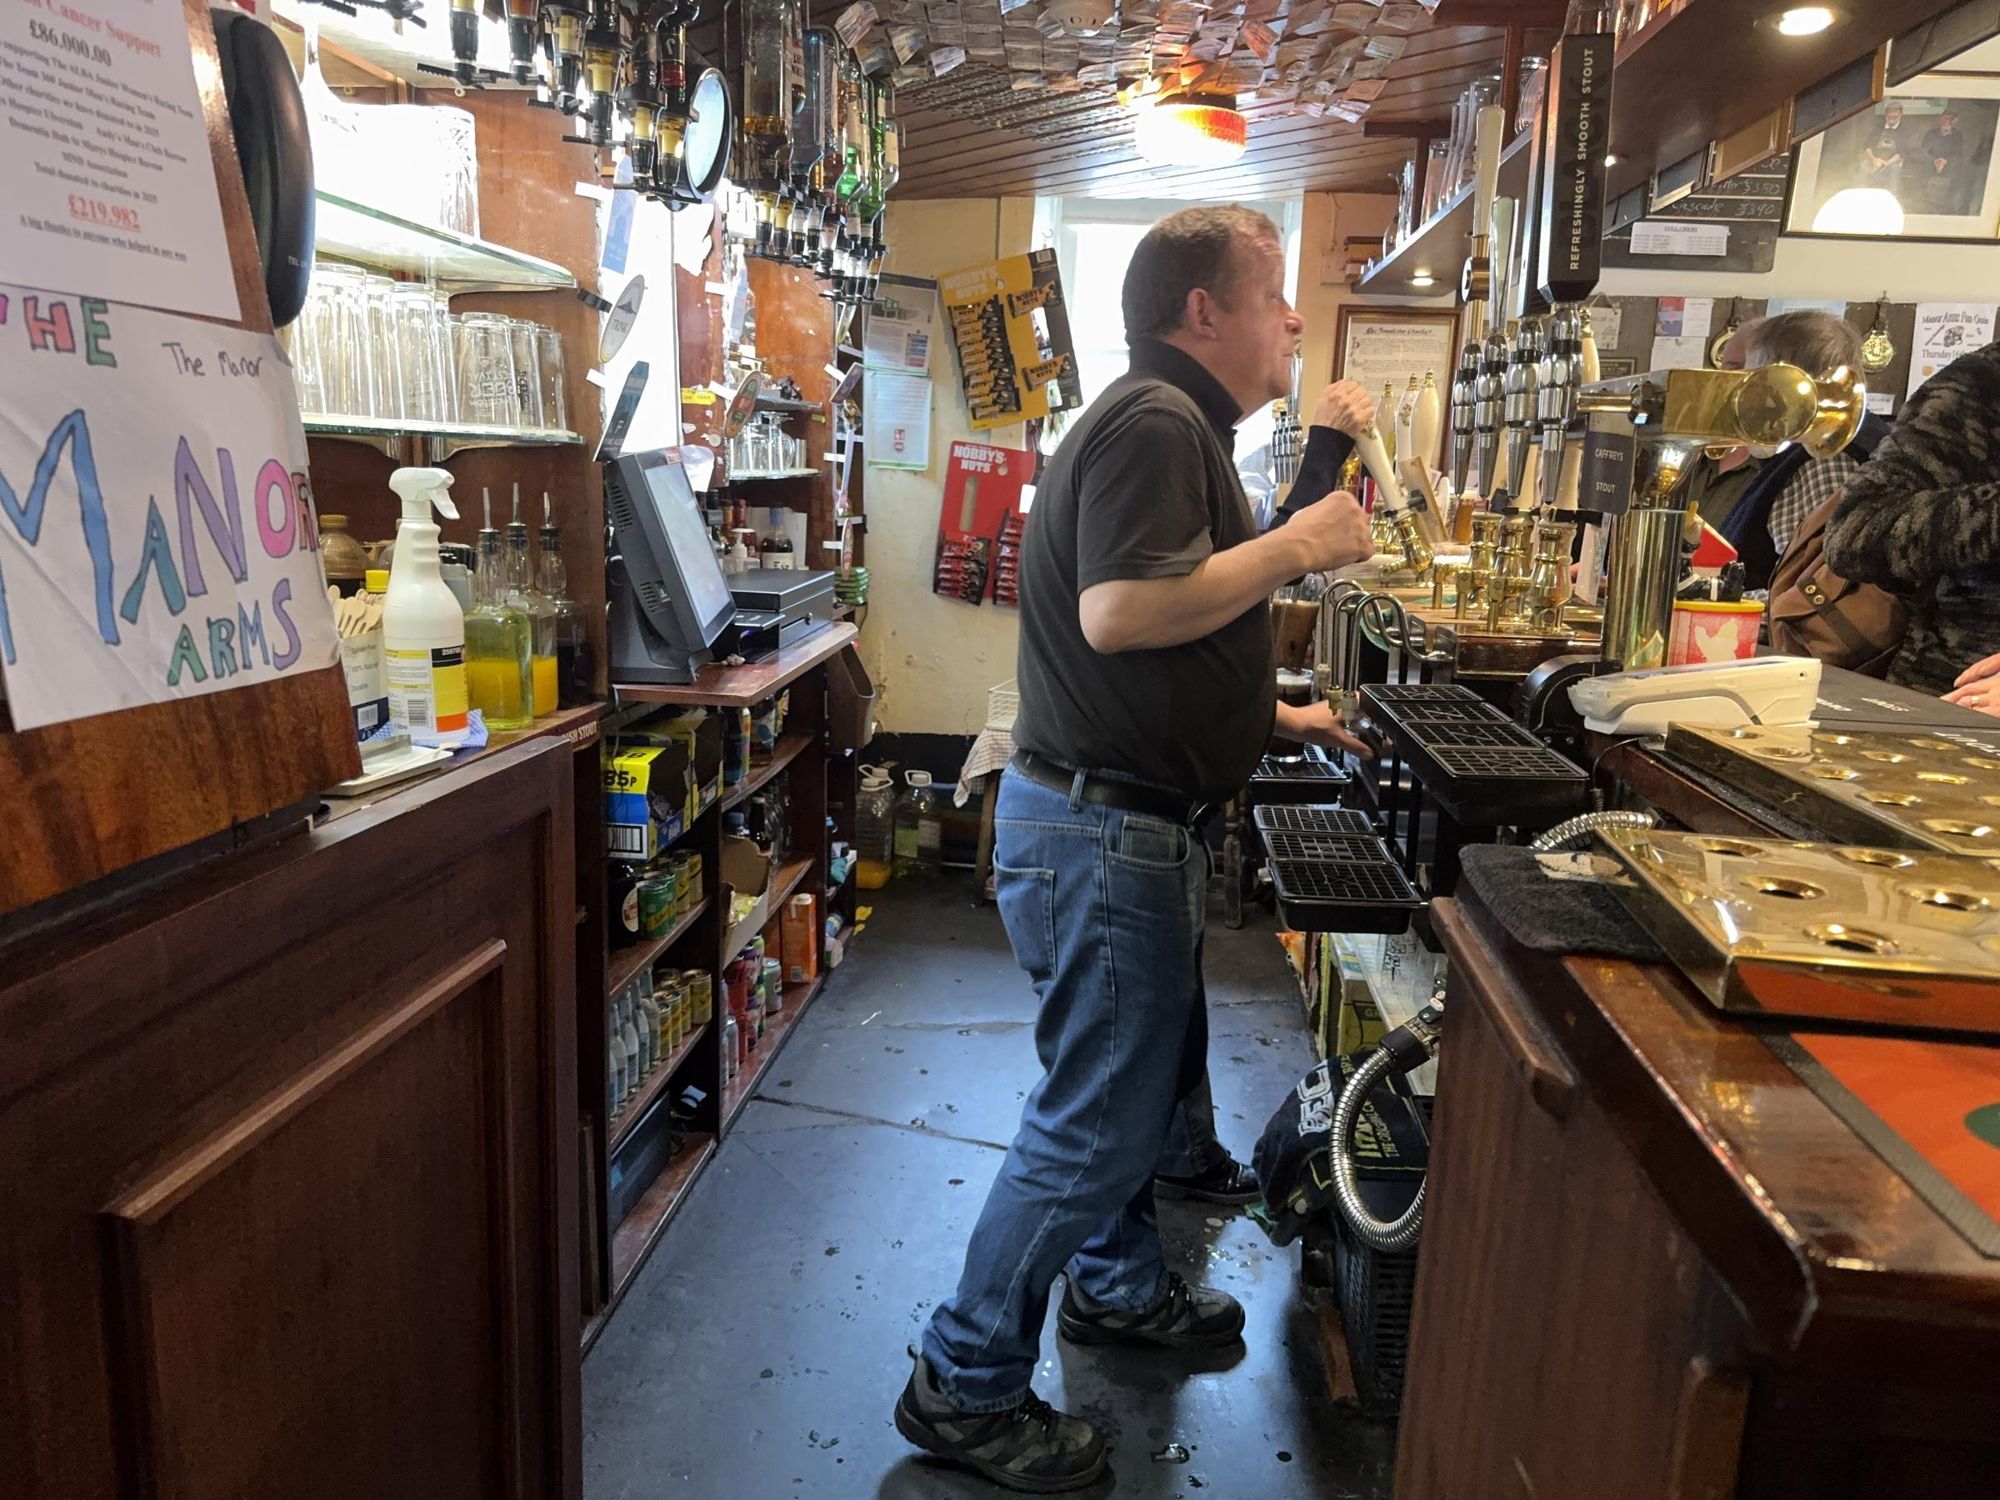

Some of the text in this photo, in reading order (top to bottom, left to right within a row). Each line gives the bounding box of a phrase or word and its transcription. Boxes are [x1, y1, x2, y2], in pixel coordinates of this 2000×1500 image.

[29, 18, 112, 66] £86.000.00
[105, 19, 161, 57] Support
[1570, 48, 1594, 271] REFRESHINGLY SMOOTH STOUT
[68, 193, 140, 230] £219.982
[161, 342, 206, 378] The
[953, 445, 1006, 465] NOBBY'S
[960, 459, 992, 474] NUTS
[1595, 481, 1615, 494] STOUT
[167, 577, 301, 687] ARMS
[578, 720, 597, 740] STOUT
